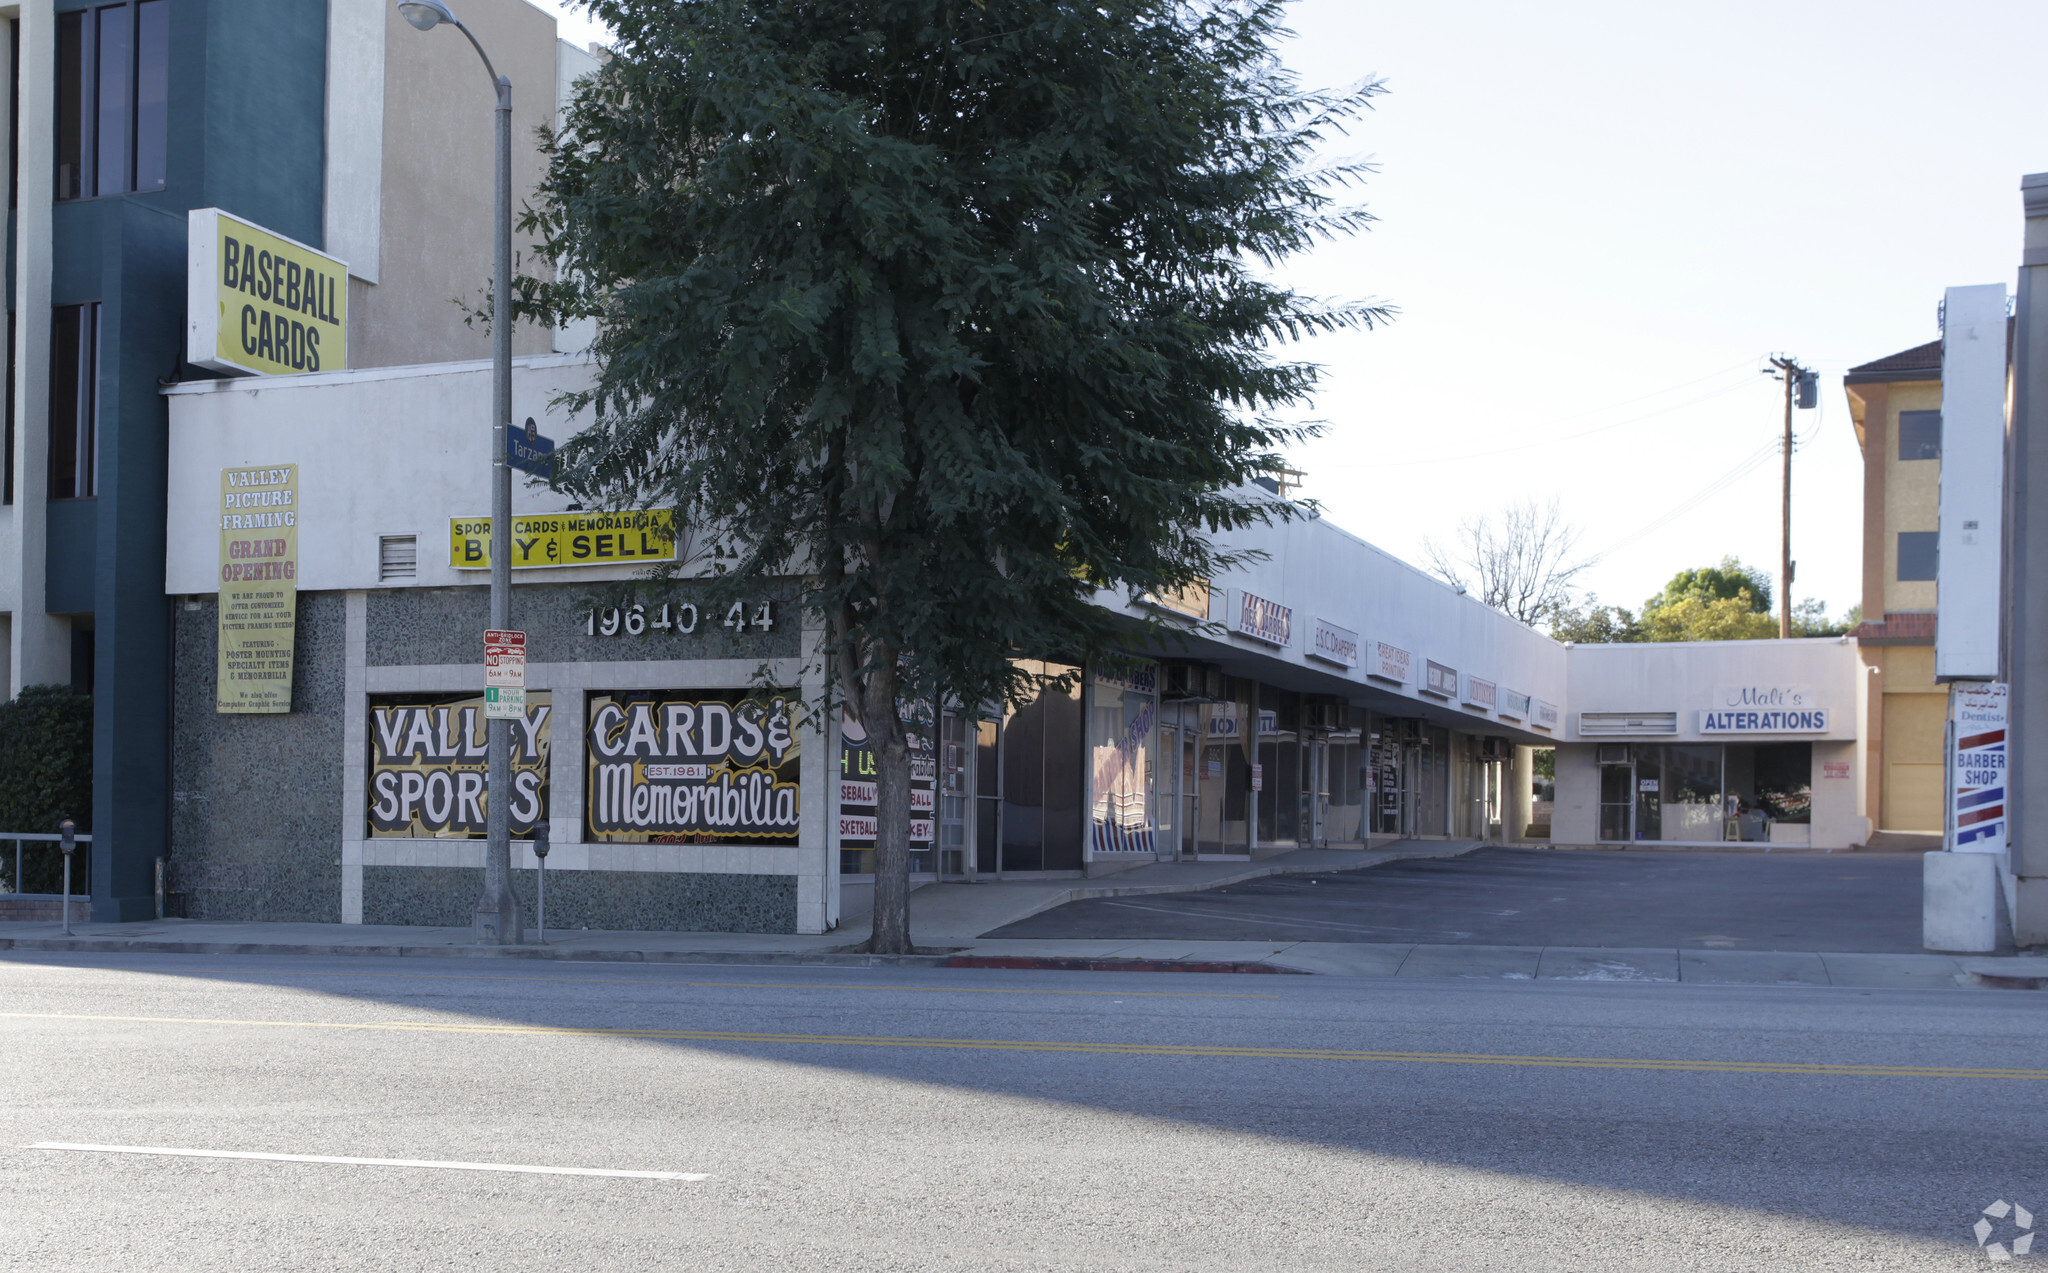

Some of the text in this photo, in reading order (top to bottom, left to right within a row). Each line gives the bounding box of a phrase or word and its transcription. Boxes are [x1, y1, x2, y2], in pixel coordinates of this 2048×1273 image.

[224, 235, 339, 326] BASEBALL
[241, 304, 320, 372] CARDS
[228, 468, 291, 487] VALLEY
[225, 489, 293, 509] PICTURE
[222, 511, 296, 531] FRAMING
[515, 520, 559, 533] CARDS
[229, 539, 286, 559] GRAND
[465, 532, 659, 562] BY & SELL
[222, 561, 295, 582] OPENING
[256, 592, 274, 600] PROUD
[276, 591, 284, 599] TO
[250, 612, 261, 620] FOR
[276, 611, 292, 619] YOUR
[247, 622, 272, 630] FRAMING
[242, 640, 275, 648] FEATURING
[226, 649, 291, 659] POSTER MOUNTING
[486, 654, 523, 666] NO STOPPING
[227, 660, 290, 669] SPECIALTY ITEMS
[238, 671, 287, 680] MEMORABILIA
[509, 669, 522, 677] 9AM
[217, 700, 246, 709] Computer
[500, 695, 523, 704] PARKING
[508, 704, 522, 712] 8PM
[1705, 711, 1824, 730] ALTERATIONS
[1961, 710, 2001, 722] Dentist
[375, 706, 550, 757] VALLY
[1958, 753, 2005, 769] BARBER
[1965, 770, 1998, 785] SHOP
[372, 771, 540, 823] SPORS
[599, 762, 799, 826] Memorabilia
[841, 785, 872, 801] SEBALL
[910, 793, 931, 807] BALL
[840, 820, 877, 835] SKETBALL
[910, 823, 929, 837] KEY
